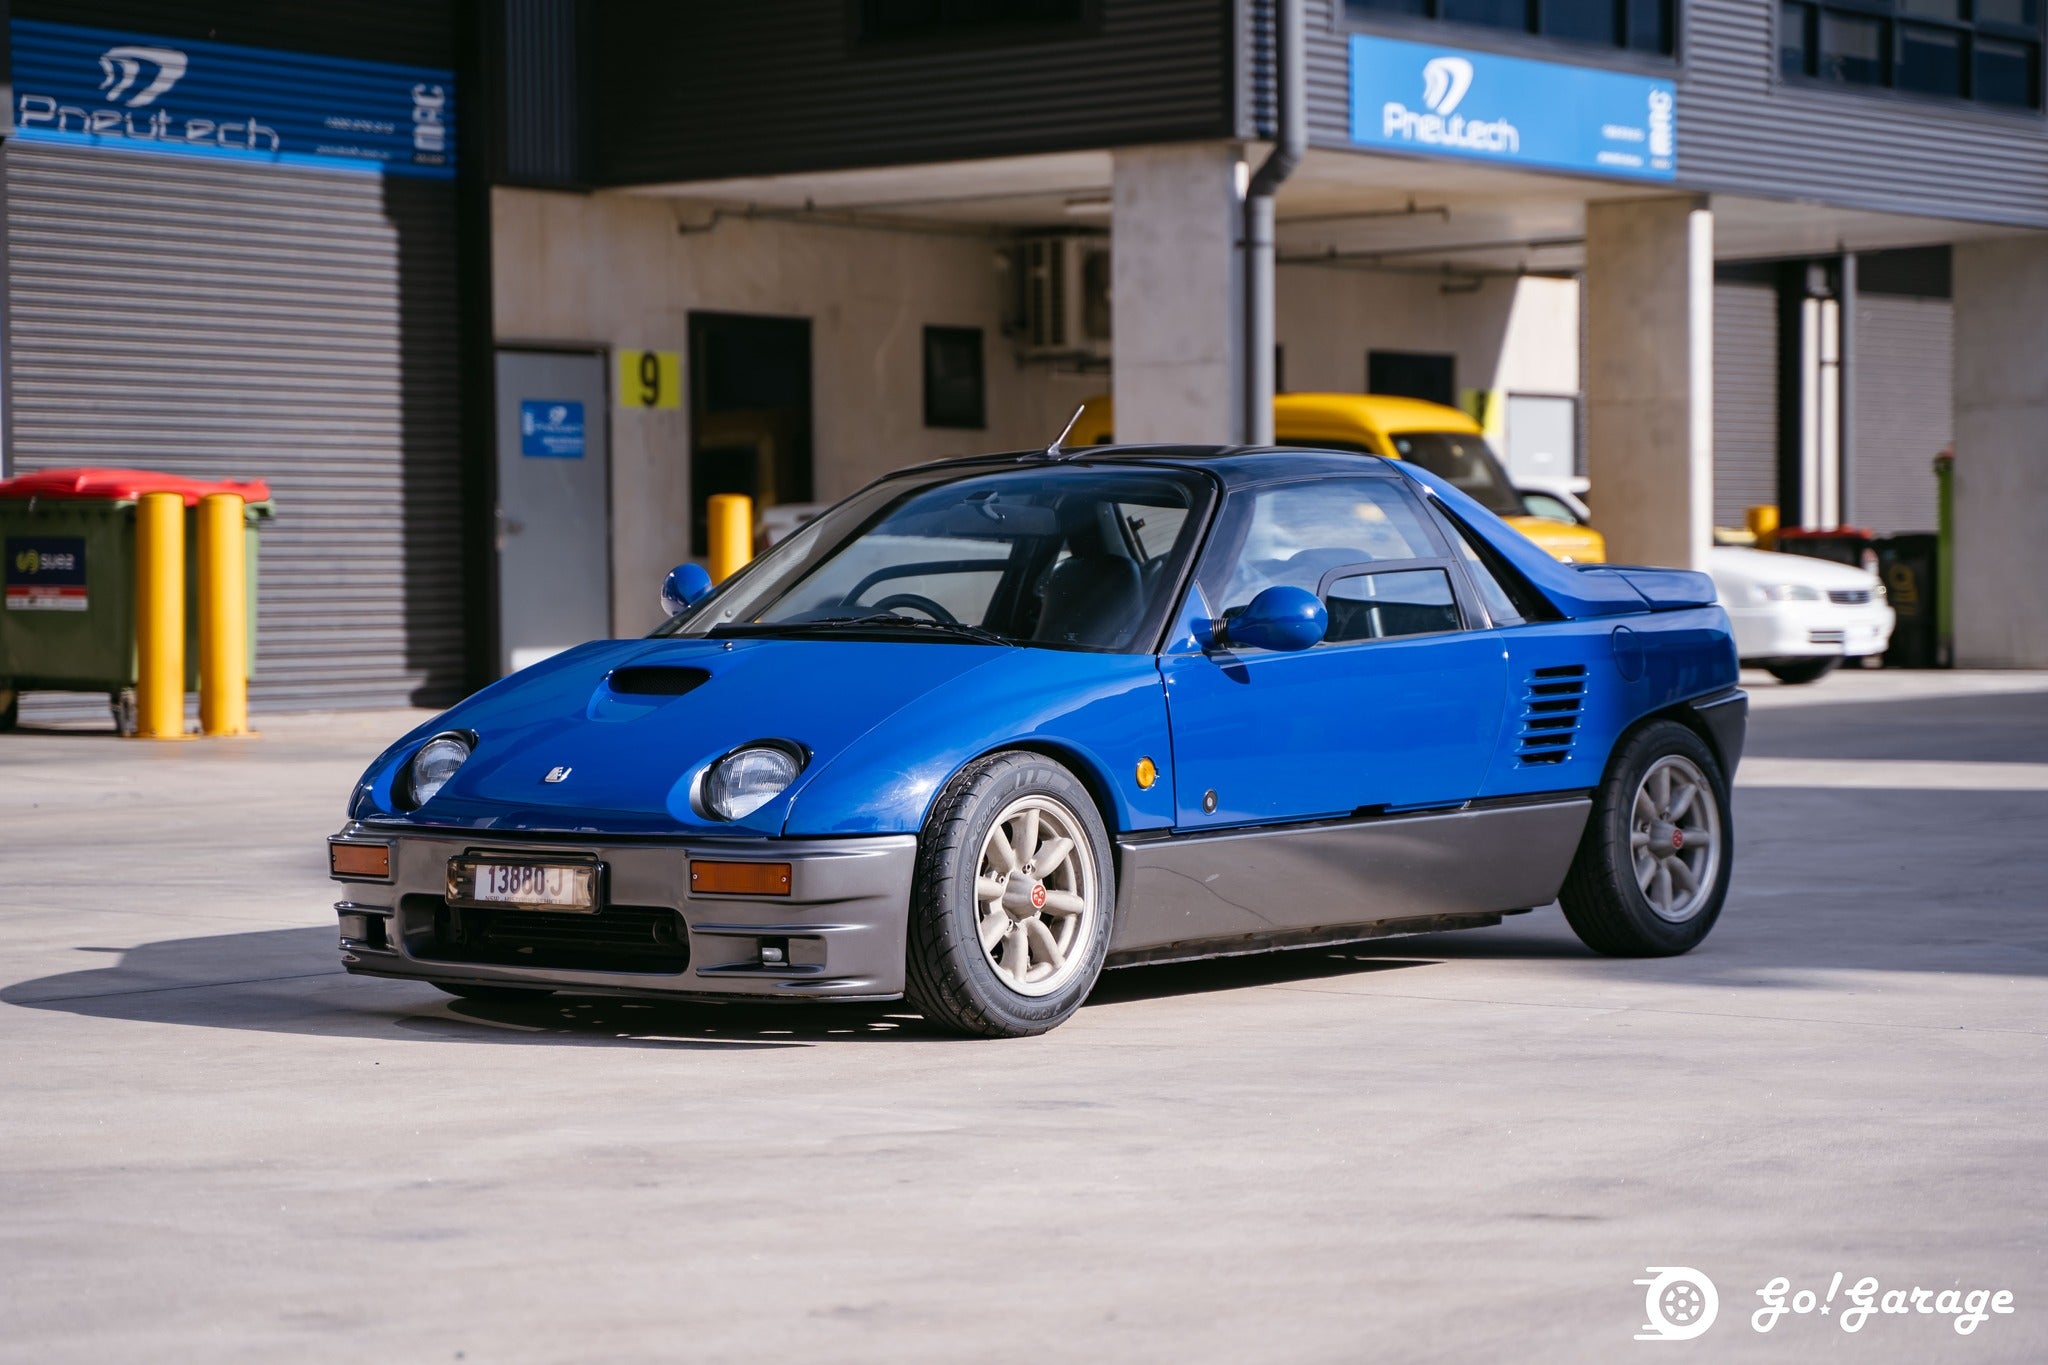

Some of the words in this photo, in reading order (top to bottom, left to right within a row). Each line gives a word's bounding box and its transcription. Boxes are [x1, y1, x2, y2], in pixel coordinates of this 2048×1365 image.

[19, 94, 280, 152] Pneutech
[1383, 101, 1520, 154] Pneutech
[640, 351, 661, 407] 9
[489, 865, 545, 895] 13880
